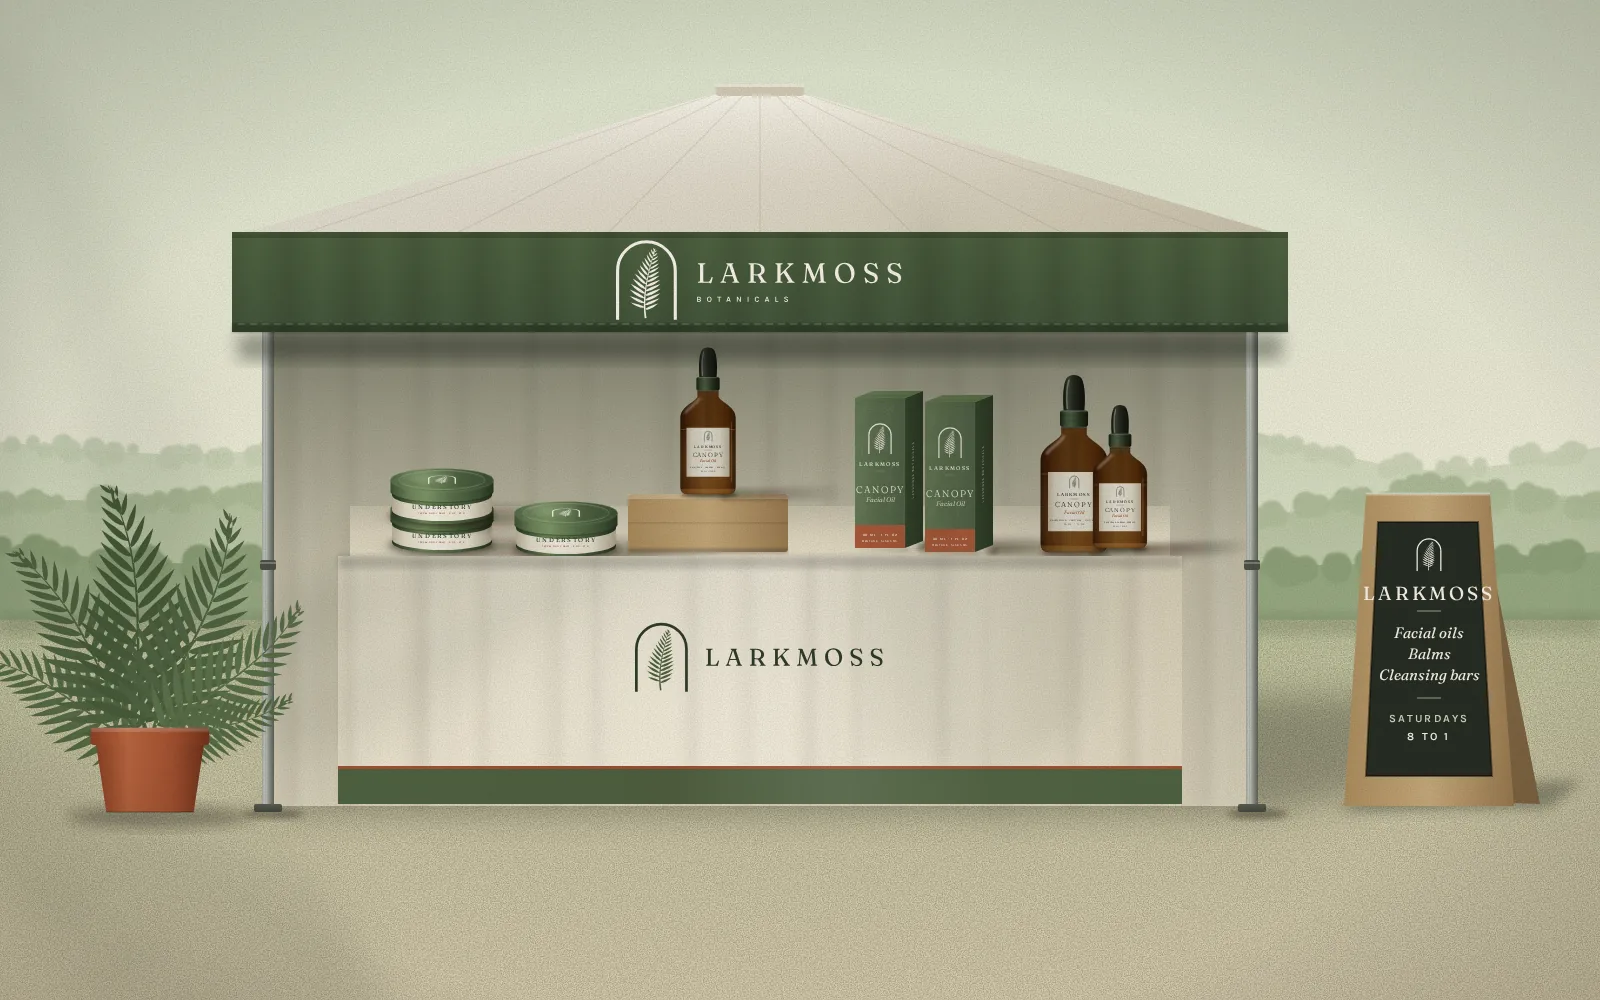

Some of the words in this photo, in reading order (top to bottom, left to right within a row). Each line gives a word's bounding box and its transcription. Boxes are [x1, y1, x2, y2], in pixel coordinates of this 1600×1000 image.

[697, 262, 903, 284] LARKMOSS
[856, 485, 904, 494] CANOPY
[926, 489, 974, 498] CANOPY
[1364, 586, 1492, 601] LARKMOSS
[1394, 626, 1436, 639] Facial
[1439, 626, 1464, 639] oils
[705, 647, 884, 667] LARKMOSS
[1408, 647, 1451, 660] Balms
[1379, 668, 1447, 684] Cleansing
[1450, 668, 1480, 682] bars
[1390, 714, 1468, 723] SATURDAYS
[1407, 732, 1414, 741] 8
[1422, 732, 1438, 741] TO
[1444, 732, 1449, 741] 1
